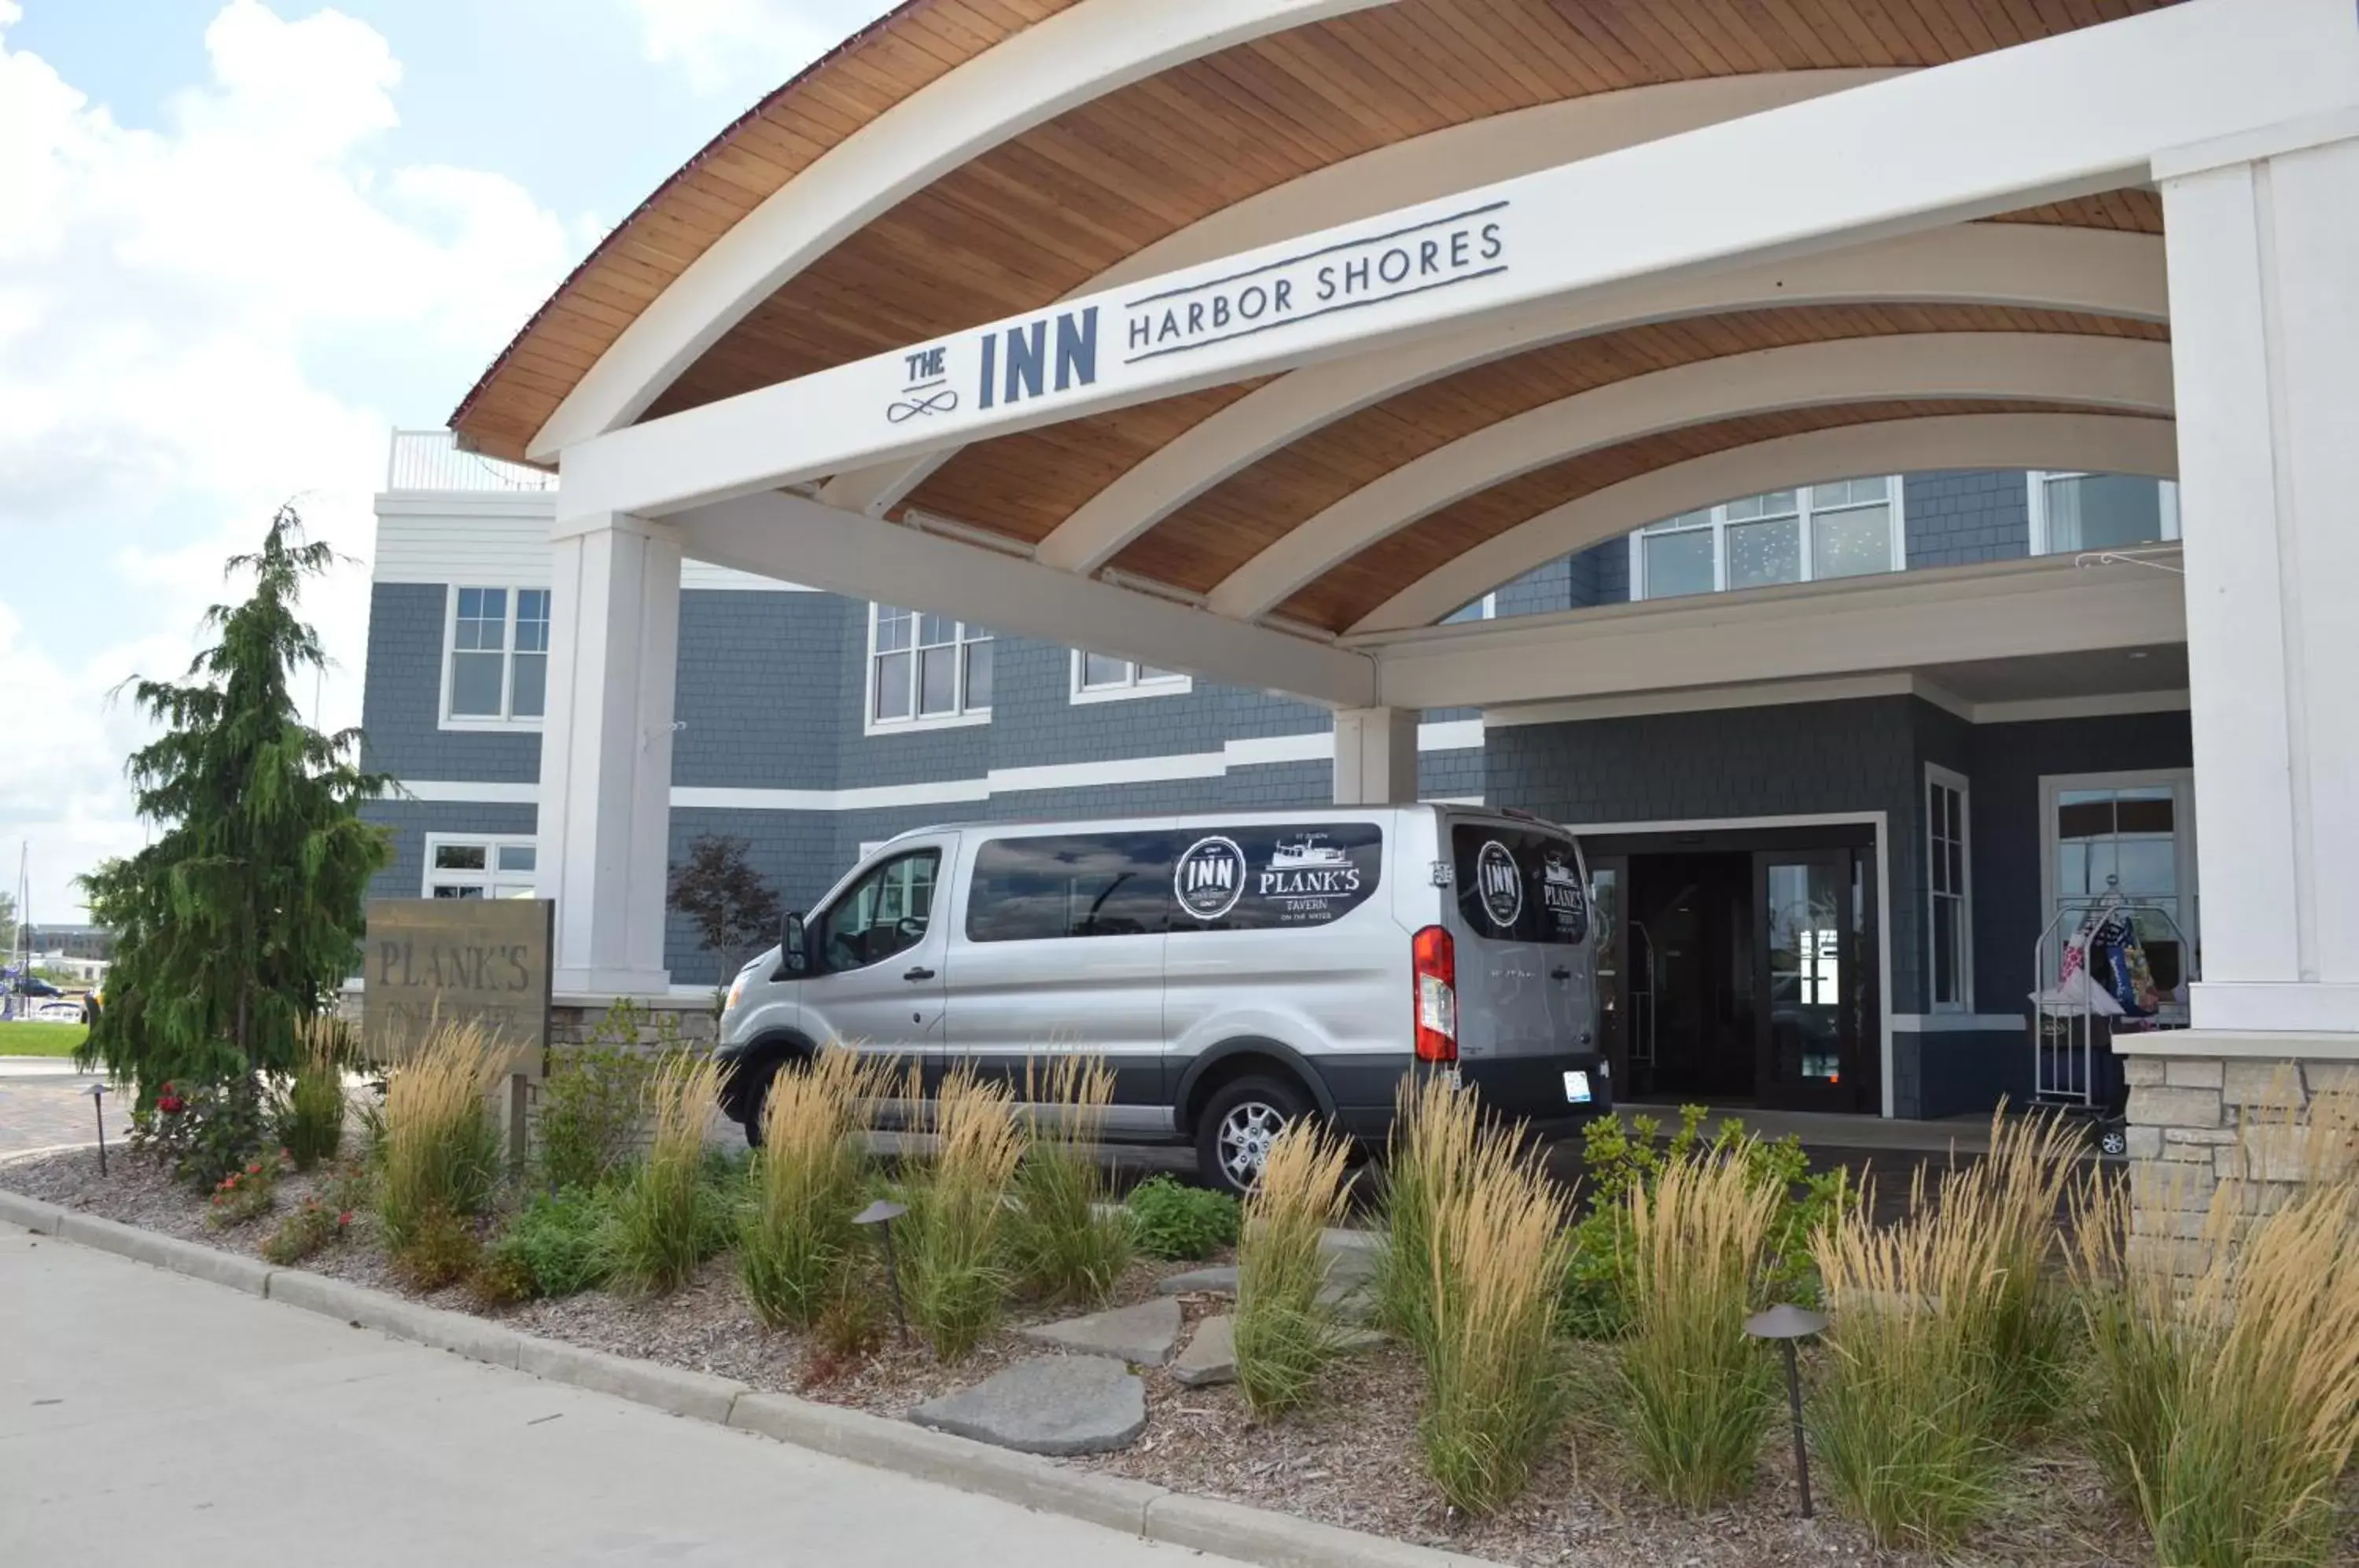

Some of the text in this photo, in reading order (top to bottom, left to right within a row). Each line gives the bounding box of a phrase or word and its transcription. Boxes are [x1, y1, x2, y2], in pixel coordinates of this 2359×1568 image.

[905, 223, 1503, 410] THE INN HARBOR SHORES
[1187, 858, 1235, 893] INN
[1259, 868, 1360, 894] PLANK'S
[1485, 863, 1516, 897] INN
[1286, 897, 1328, 911] TAVERN
[377, 940, 530, 993] PLANK'S
